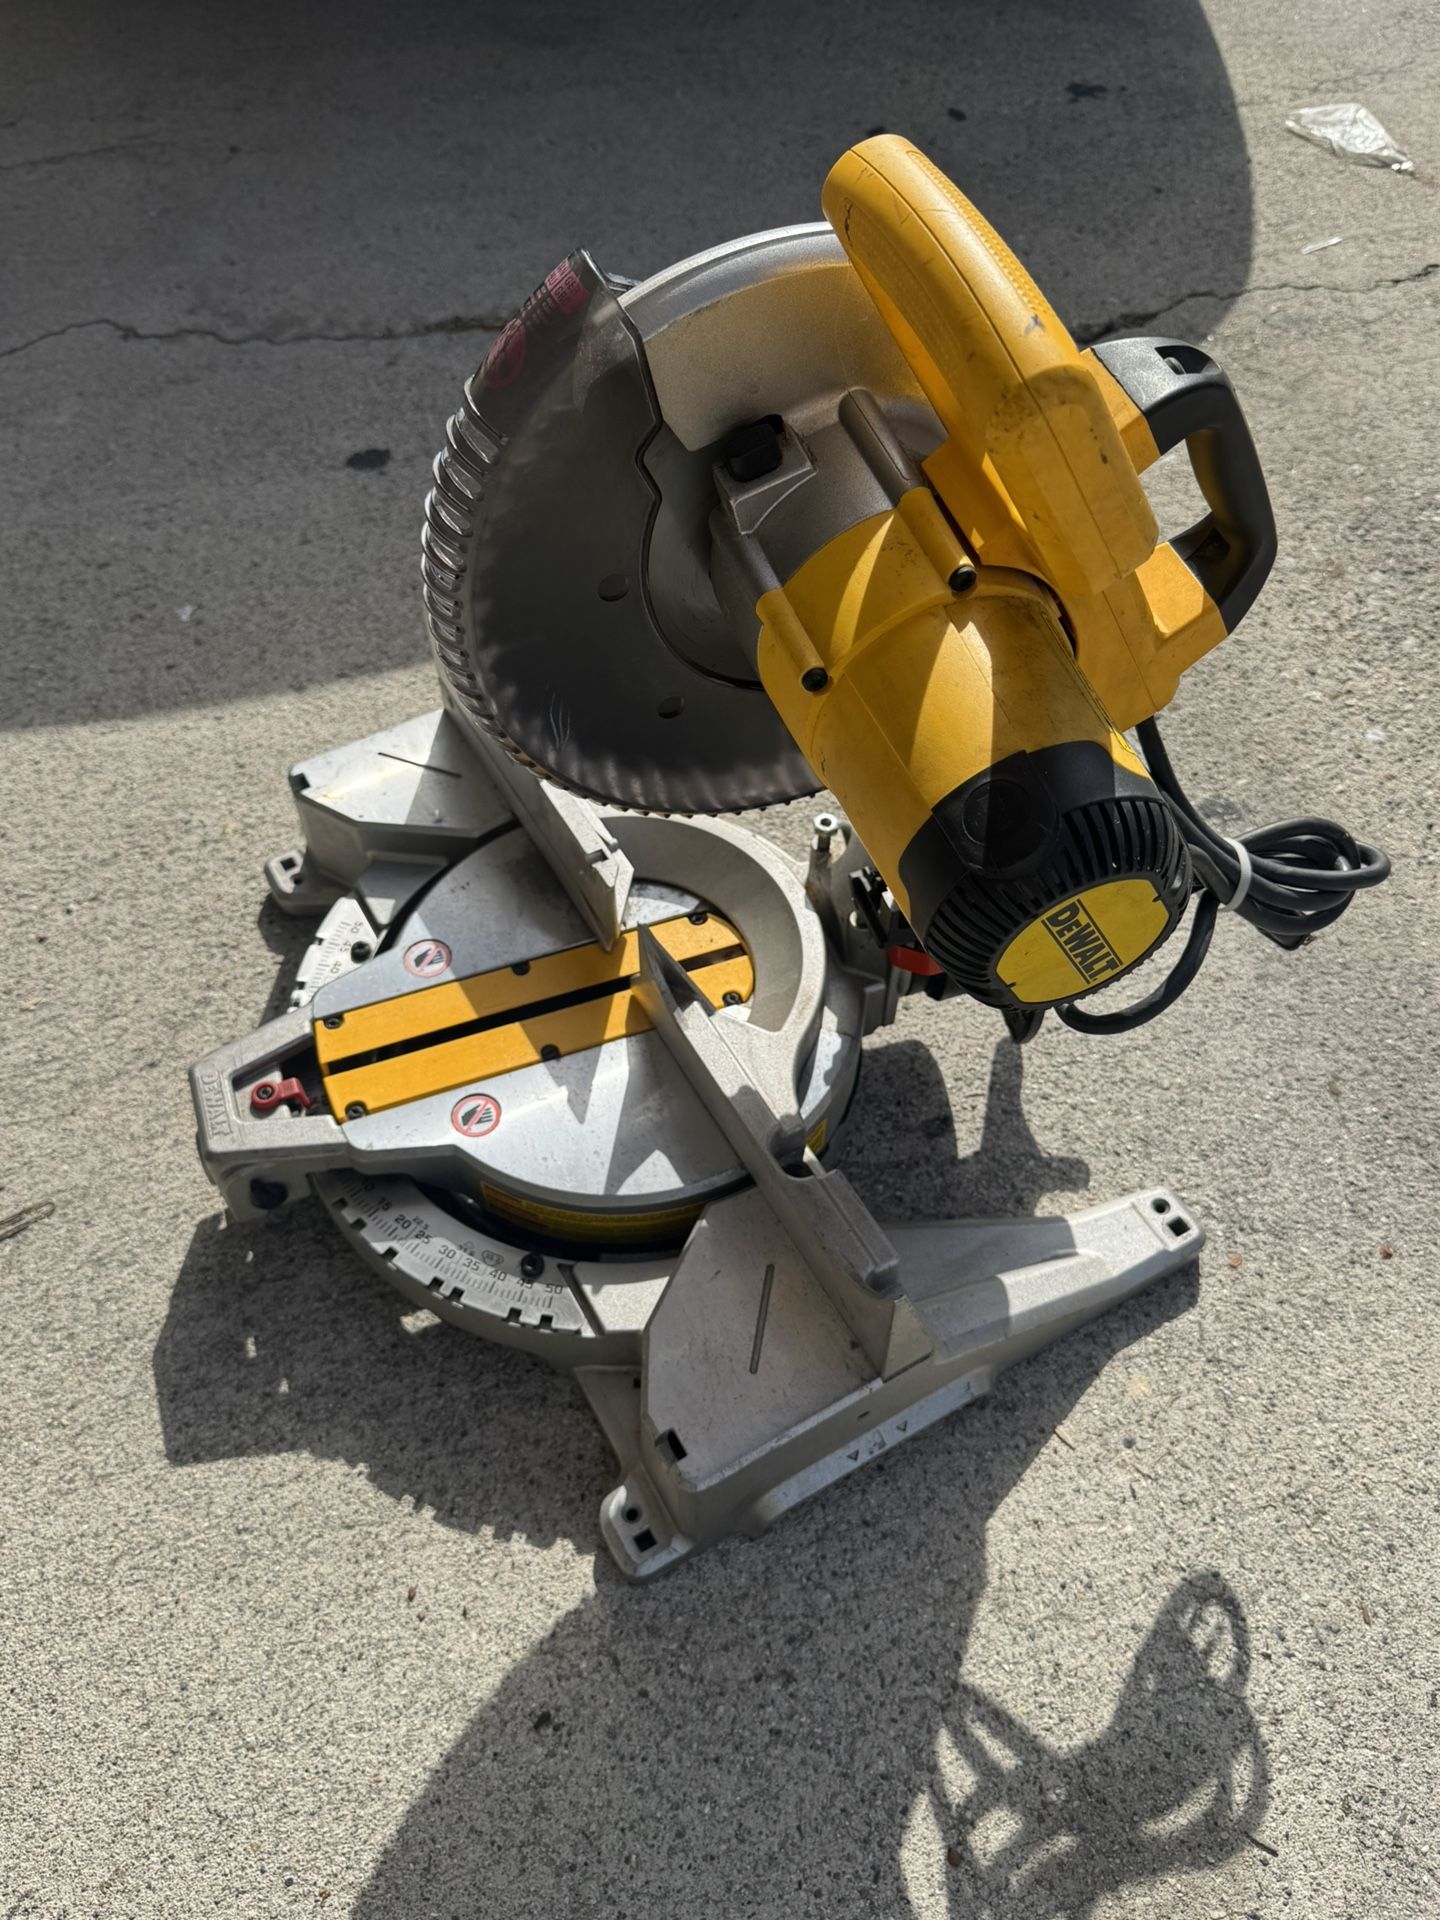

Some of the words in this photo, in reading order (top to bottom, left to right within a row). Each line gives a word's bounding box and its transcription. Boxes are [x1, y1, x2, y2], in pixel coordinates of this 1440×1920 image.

[1045, 902, 1120, 981] DEWALT
[378, 1197, 391, 1210] 15
[394, 1214, 412, 1230] 20
[414, 1230, 433, 1245] 25
[438, 1244, 457, 1260] 30
[462, 1257, 481, 1272] 35
[489, 1269, 507, 1281] 40
[516, 1278, 534, 1290] 45
[543, 1283, 563, 1295] 50
